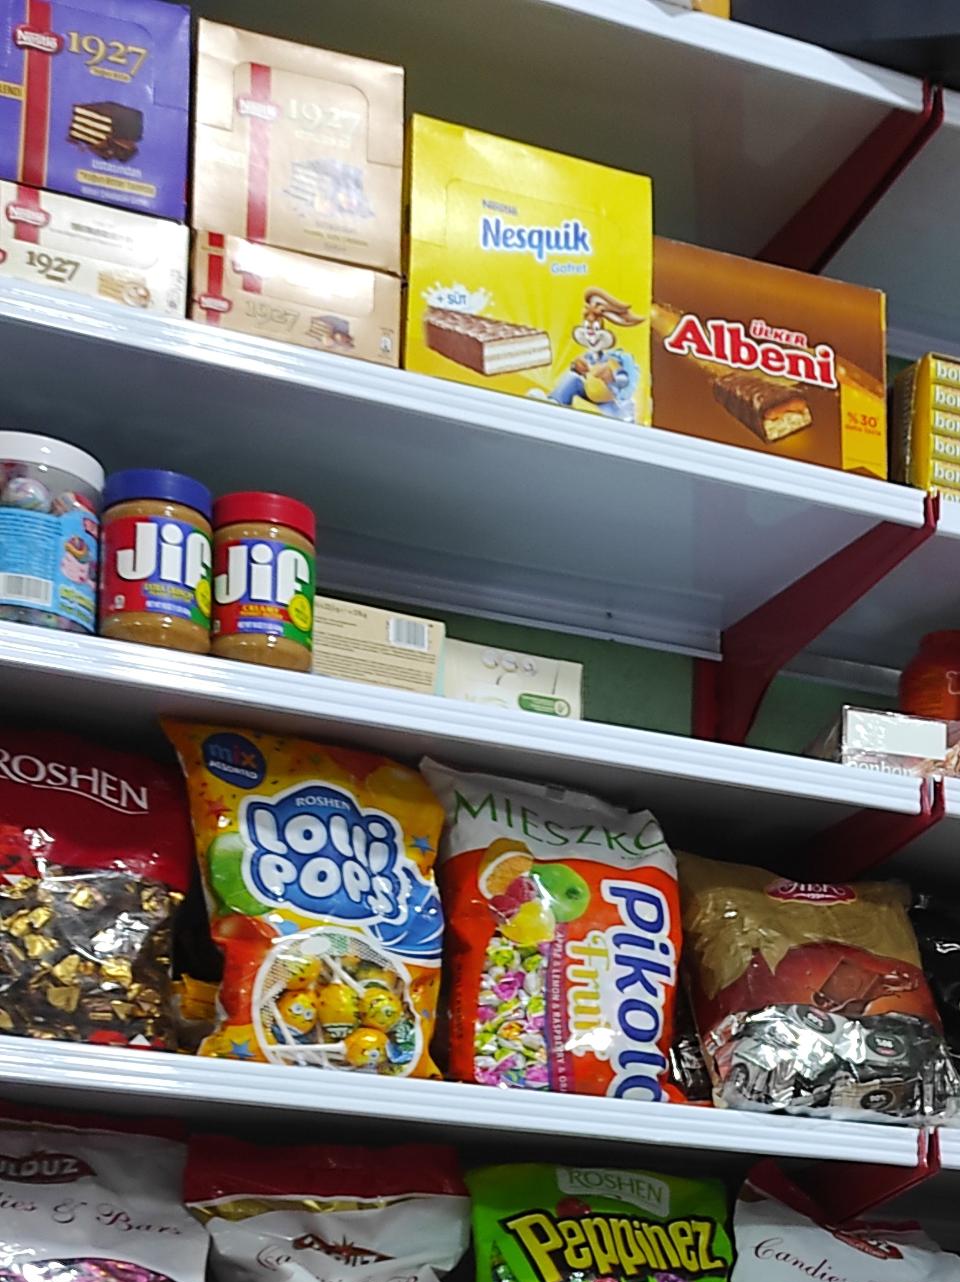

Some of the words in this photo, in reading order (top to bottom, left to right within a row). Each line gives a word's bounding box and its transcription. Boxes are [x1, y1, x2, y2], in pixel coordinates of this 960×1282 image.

[68, 32, 148, 77] 1927
[481, 217, 592, 262] Nesquik
[26, 251, 80, 282] 1927
[550, 263, 588, 275] Gofret
[665, 315, 838, 389] Albeni
[751, 319, 808, 347] ÜLKER
[116, 521, 211, 589] Jif
[214, 543, 310, 605] Jif
[210, 743, 257, 768] mix
[296, 796, 350, 810] ROSHEN
[454, 790, 665, 856] MIESZKO
[551, 969, 561, 1001] LEMON
[607, 884, 671, 1102] Pikolo
[568, 1169, 664, 1202] ROSHEN
